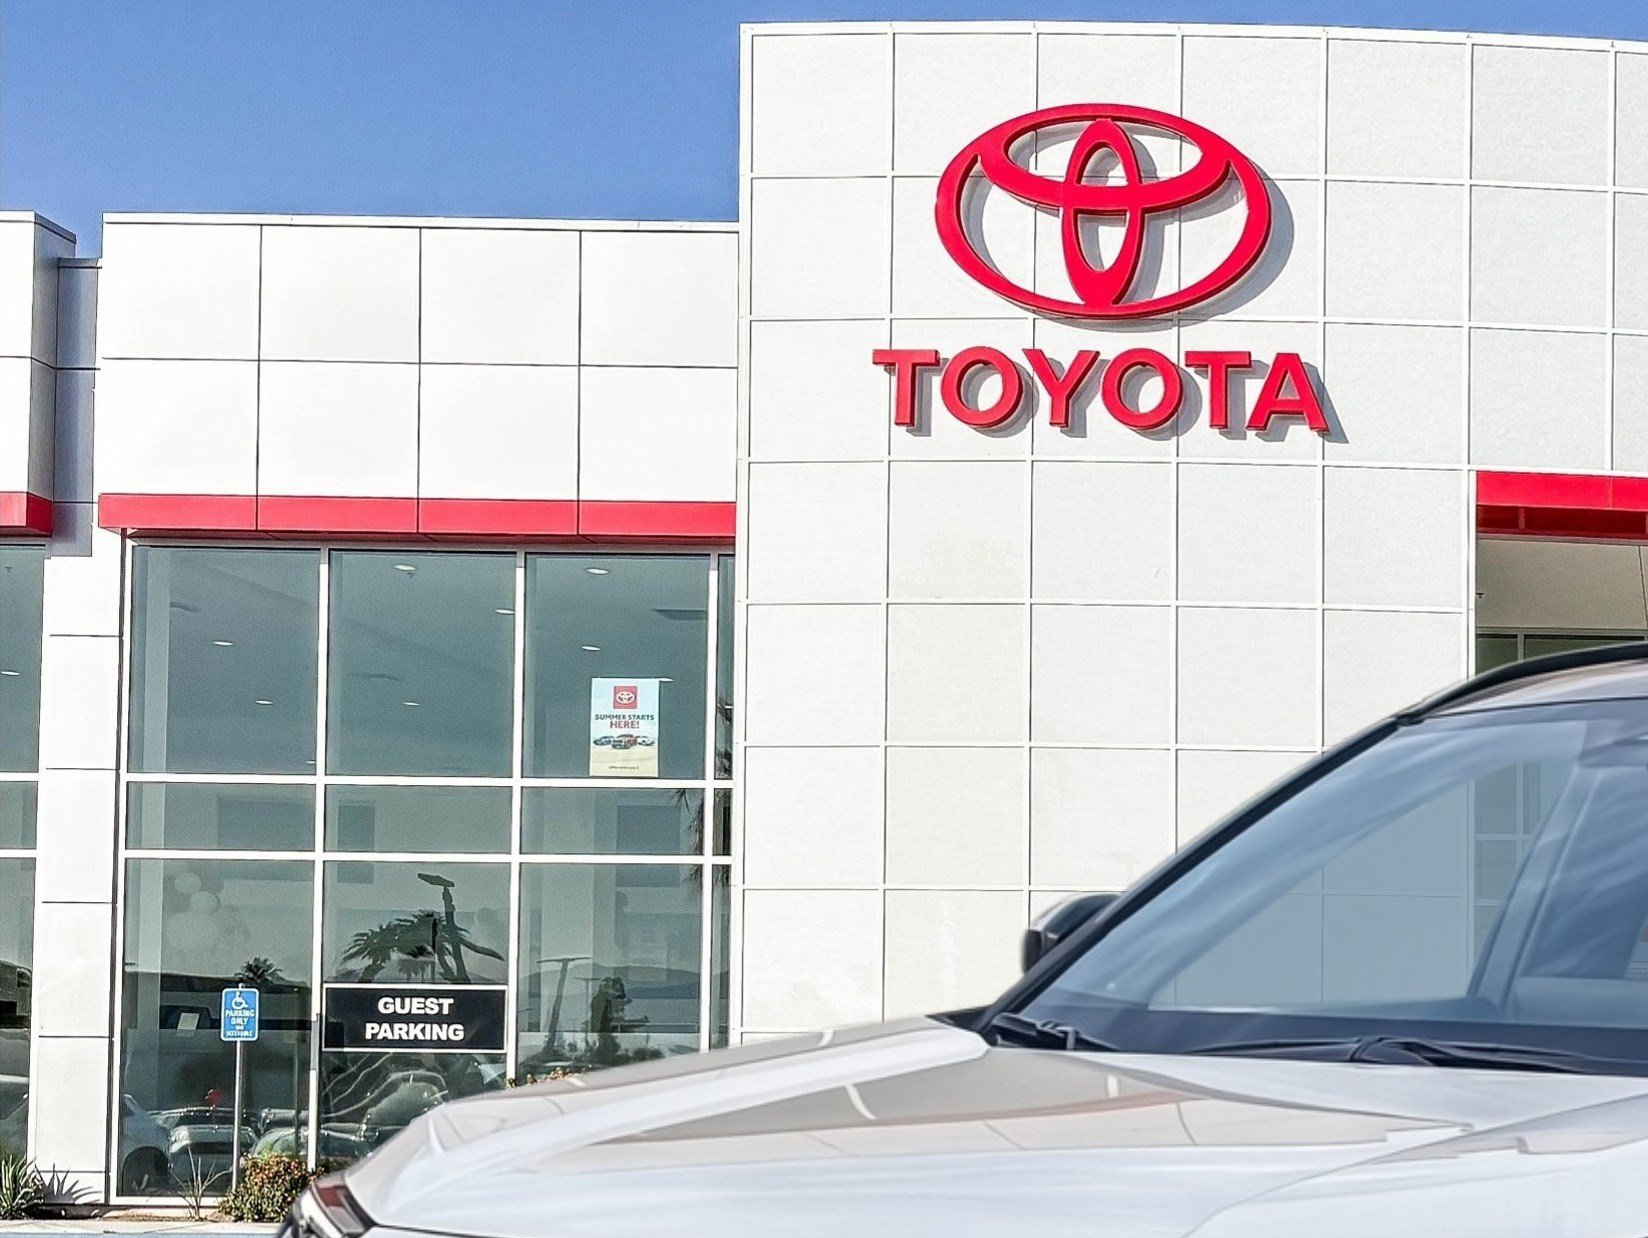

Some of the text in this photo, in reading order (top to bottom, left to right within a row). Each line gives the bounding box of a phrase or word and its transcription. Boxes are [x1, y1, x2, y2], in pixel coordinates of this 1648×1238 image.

[873, 346, 1329, 434] TOYOTA
[610, 720, 640, 729] HERE!
[377, 996, 455, 1015] GUEST
[365, 1022, 465, 1041] PARKING
